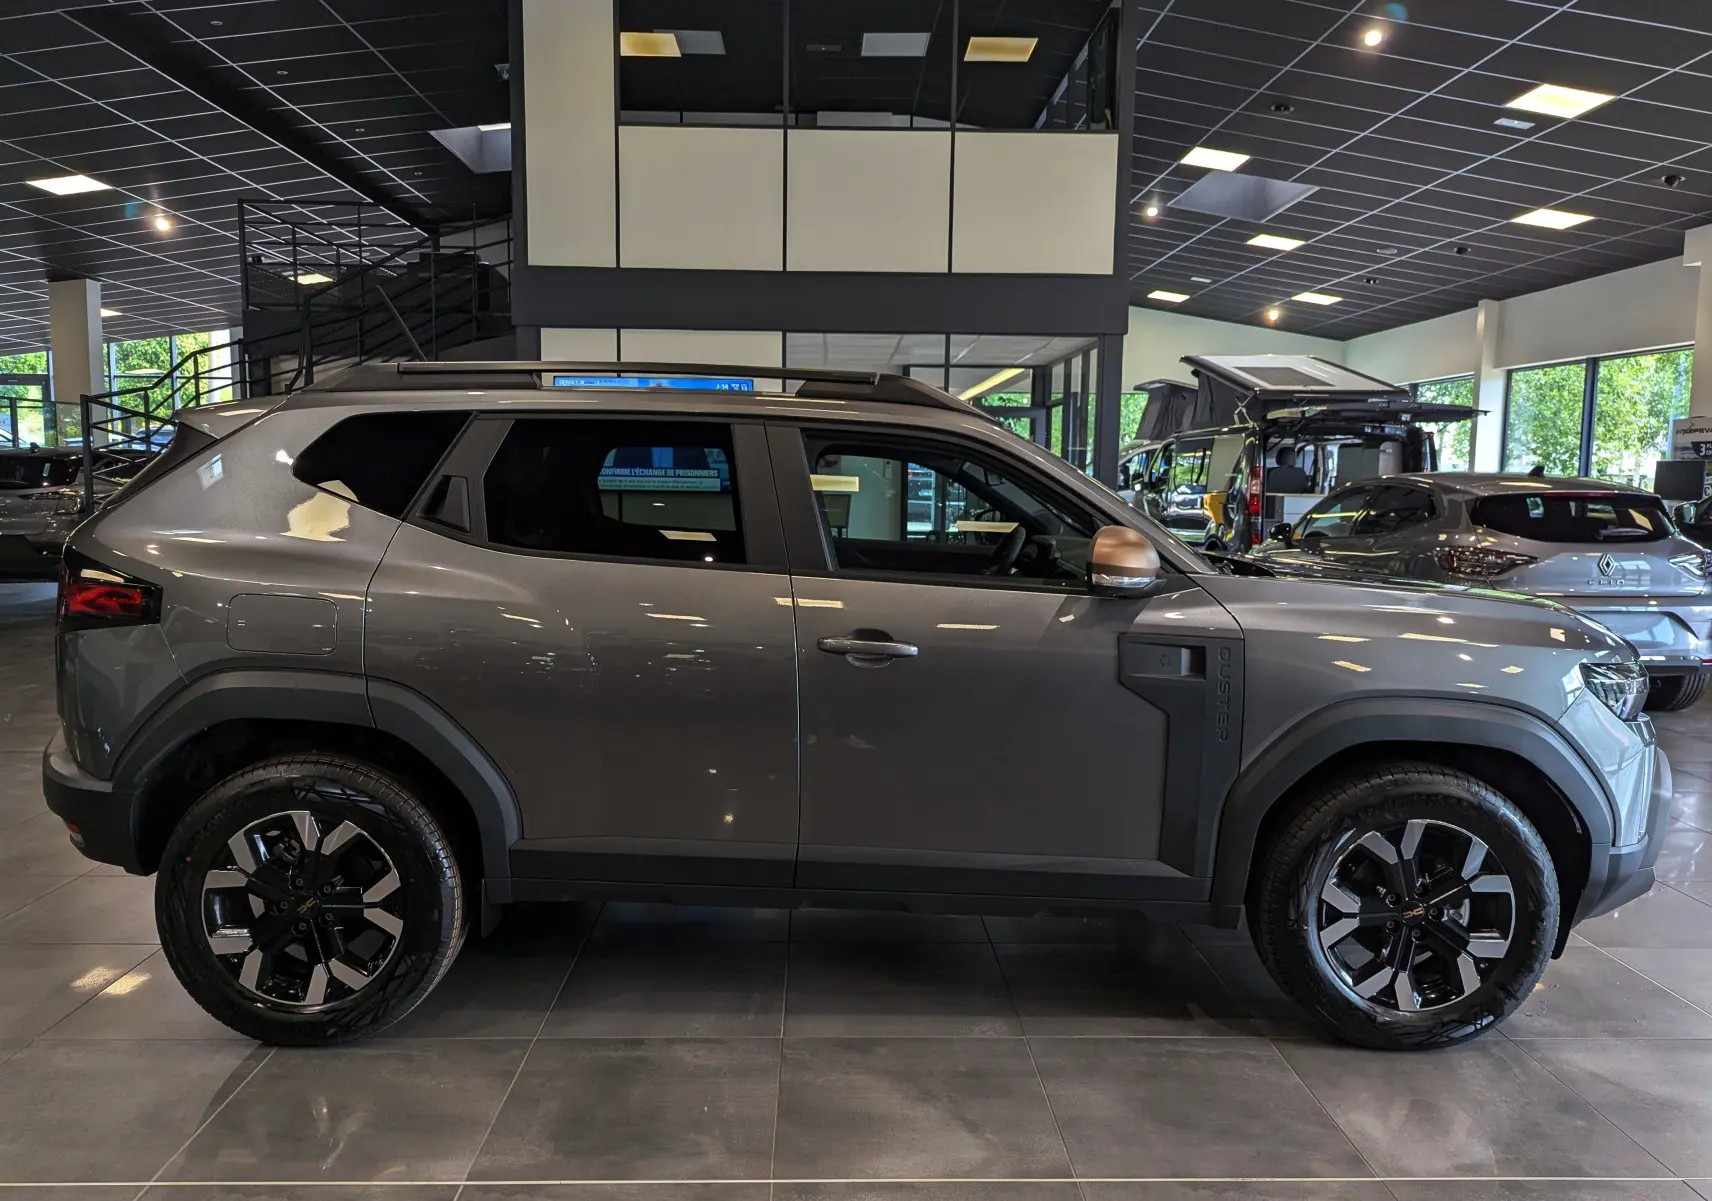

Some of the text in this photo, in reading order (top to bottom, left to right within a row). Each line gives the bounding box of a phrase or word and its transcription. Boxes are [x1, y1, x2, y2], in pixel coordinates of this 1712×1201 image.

[1699, 443, 1706, 456] 3
[600, 466, 718, 477] ONFIRME L'ÉCHANGE DE PRISONNIERS
[1216, 646, 1231, 742] DUSTER
